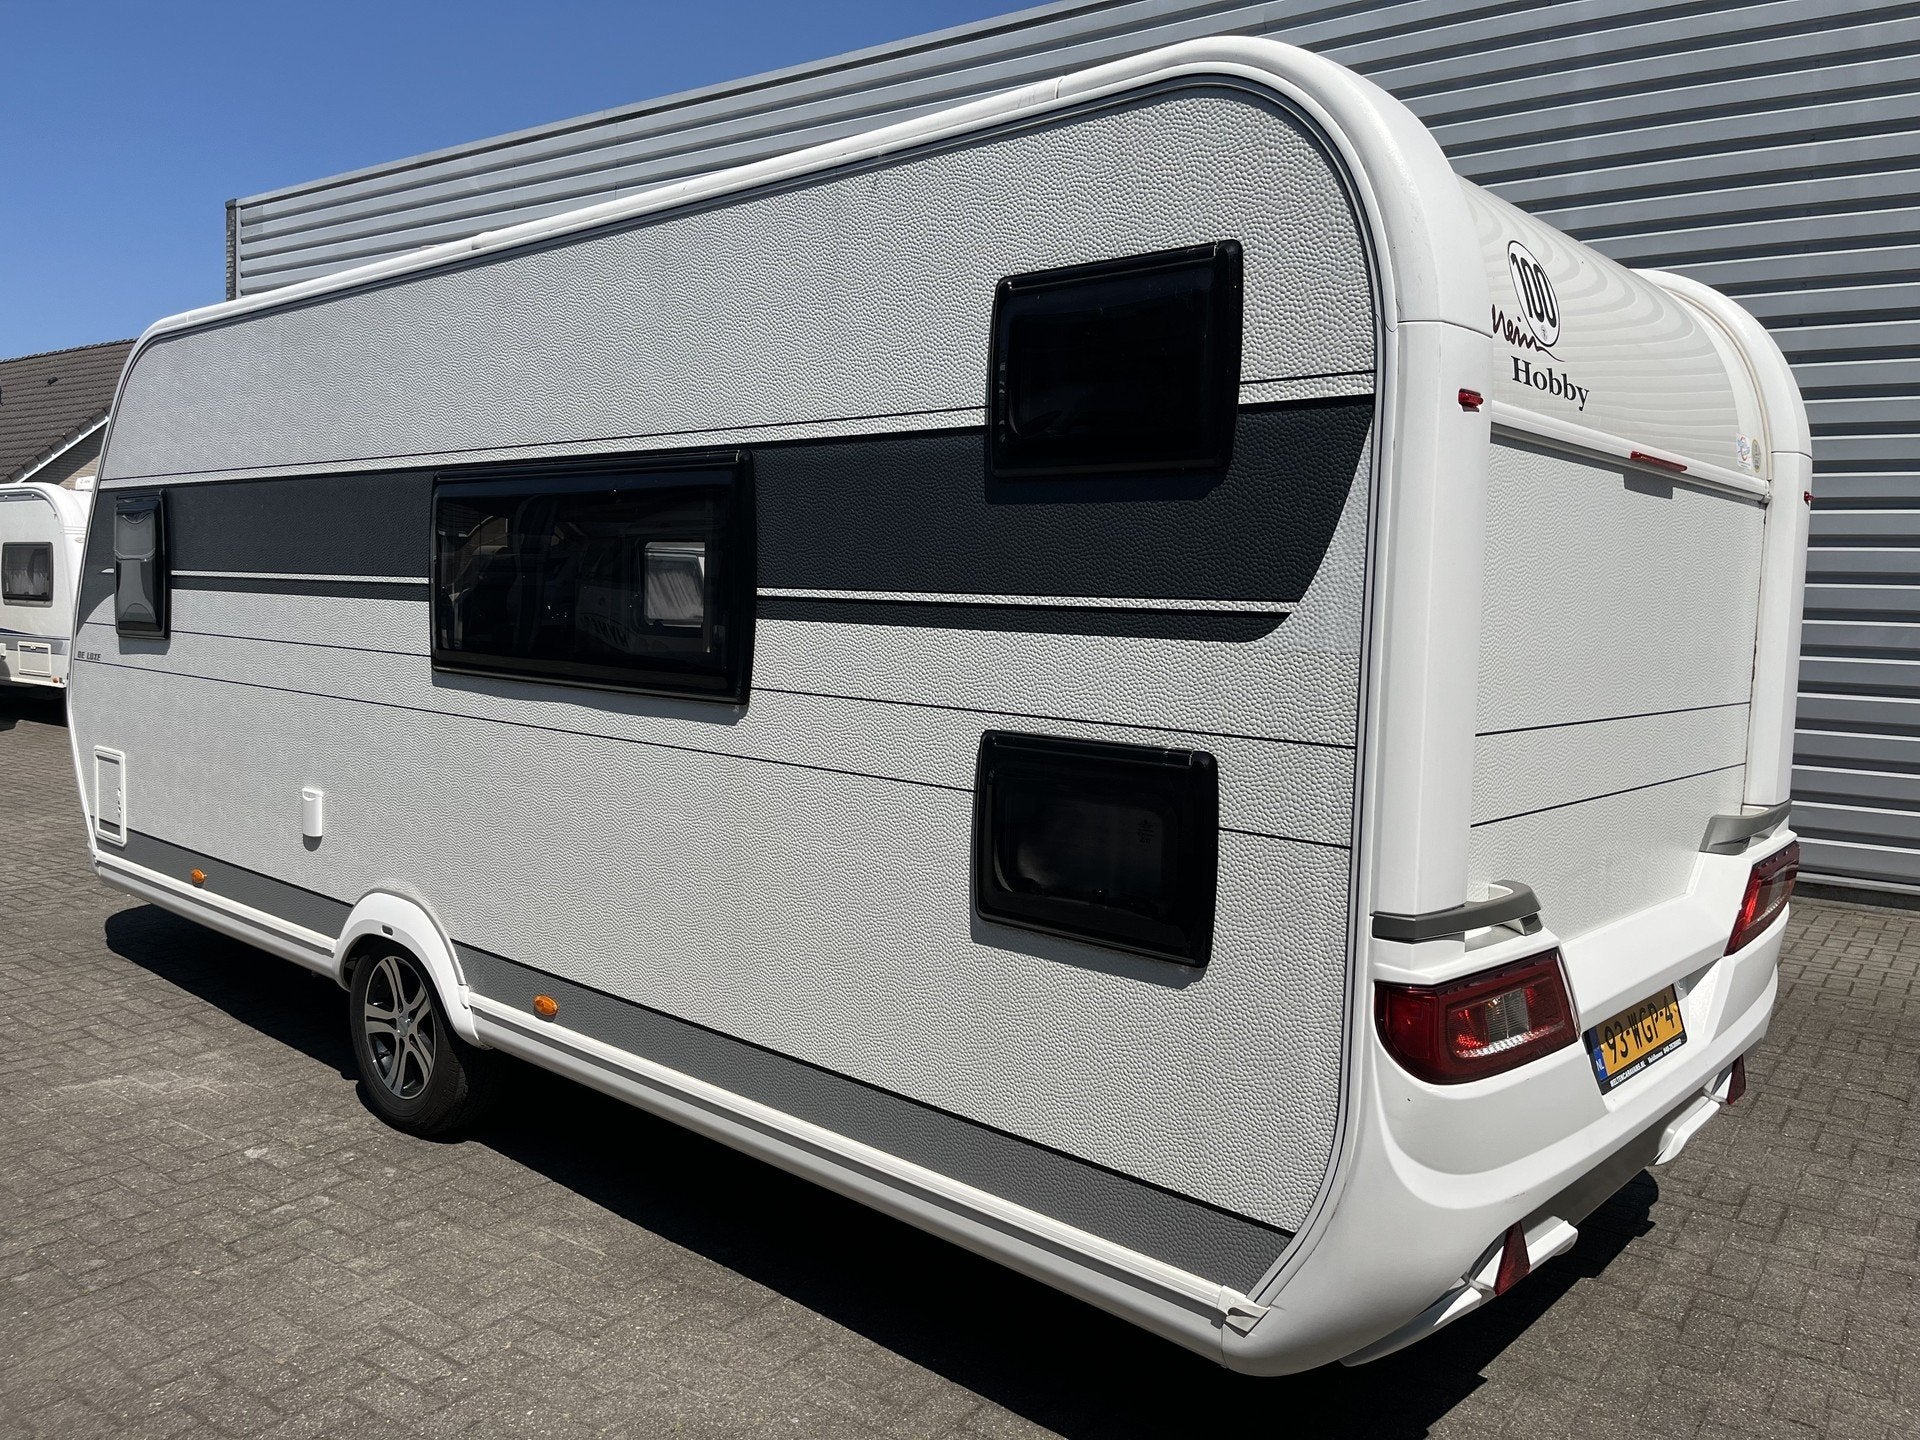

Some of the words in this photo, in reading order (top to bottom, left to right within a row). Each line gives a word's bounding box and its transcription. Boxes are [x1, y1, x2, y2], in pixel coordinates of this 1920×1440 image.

[1510, 252, 1557, 329] 100
[1510, 355, 1590, 412] Hobby
[1604, 995, 1675, 1065] 93-WGP-4
[1595, 1057, 1605, 1072] NL
